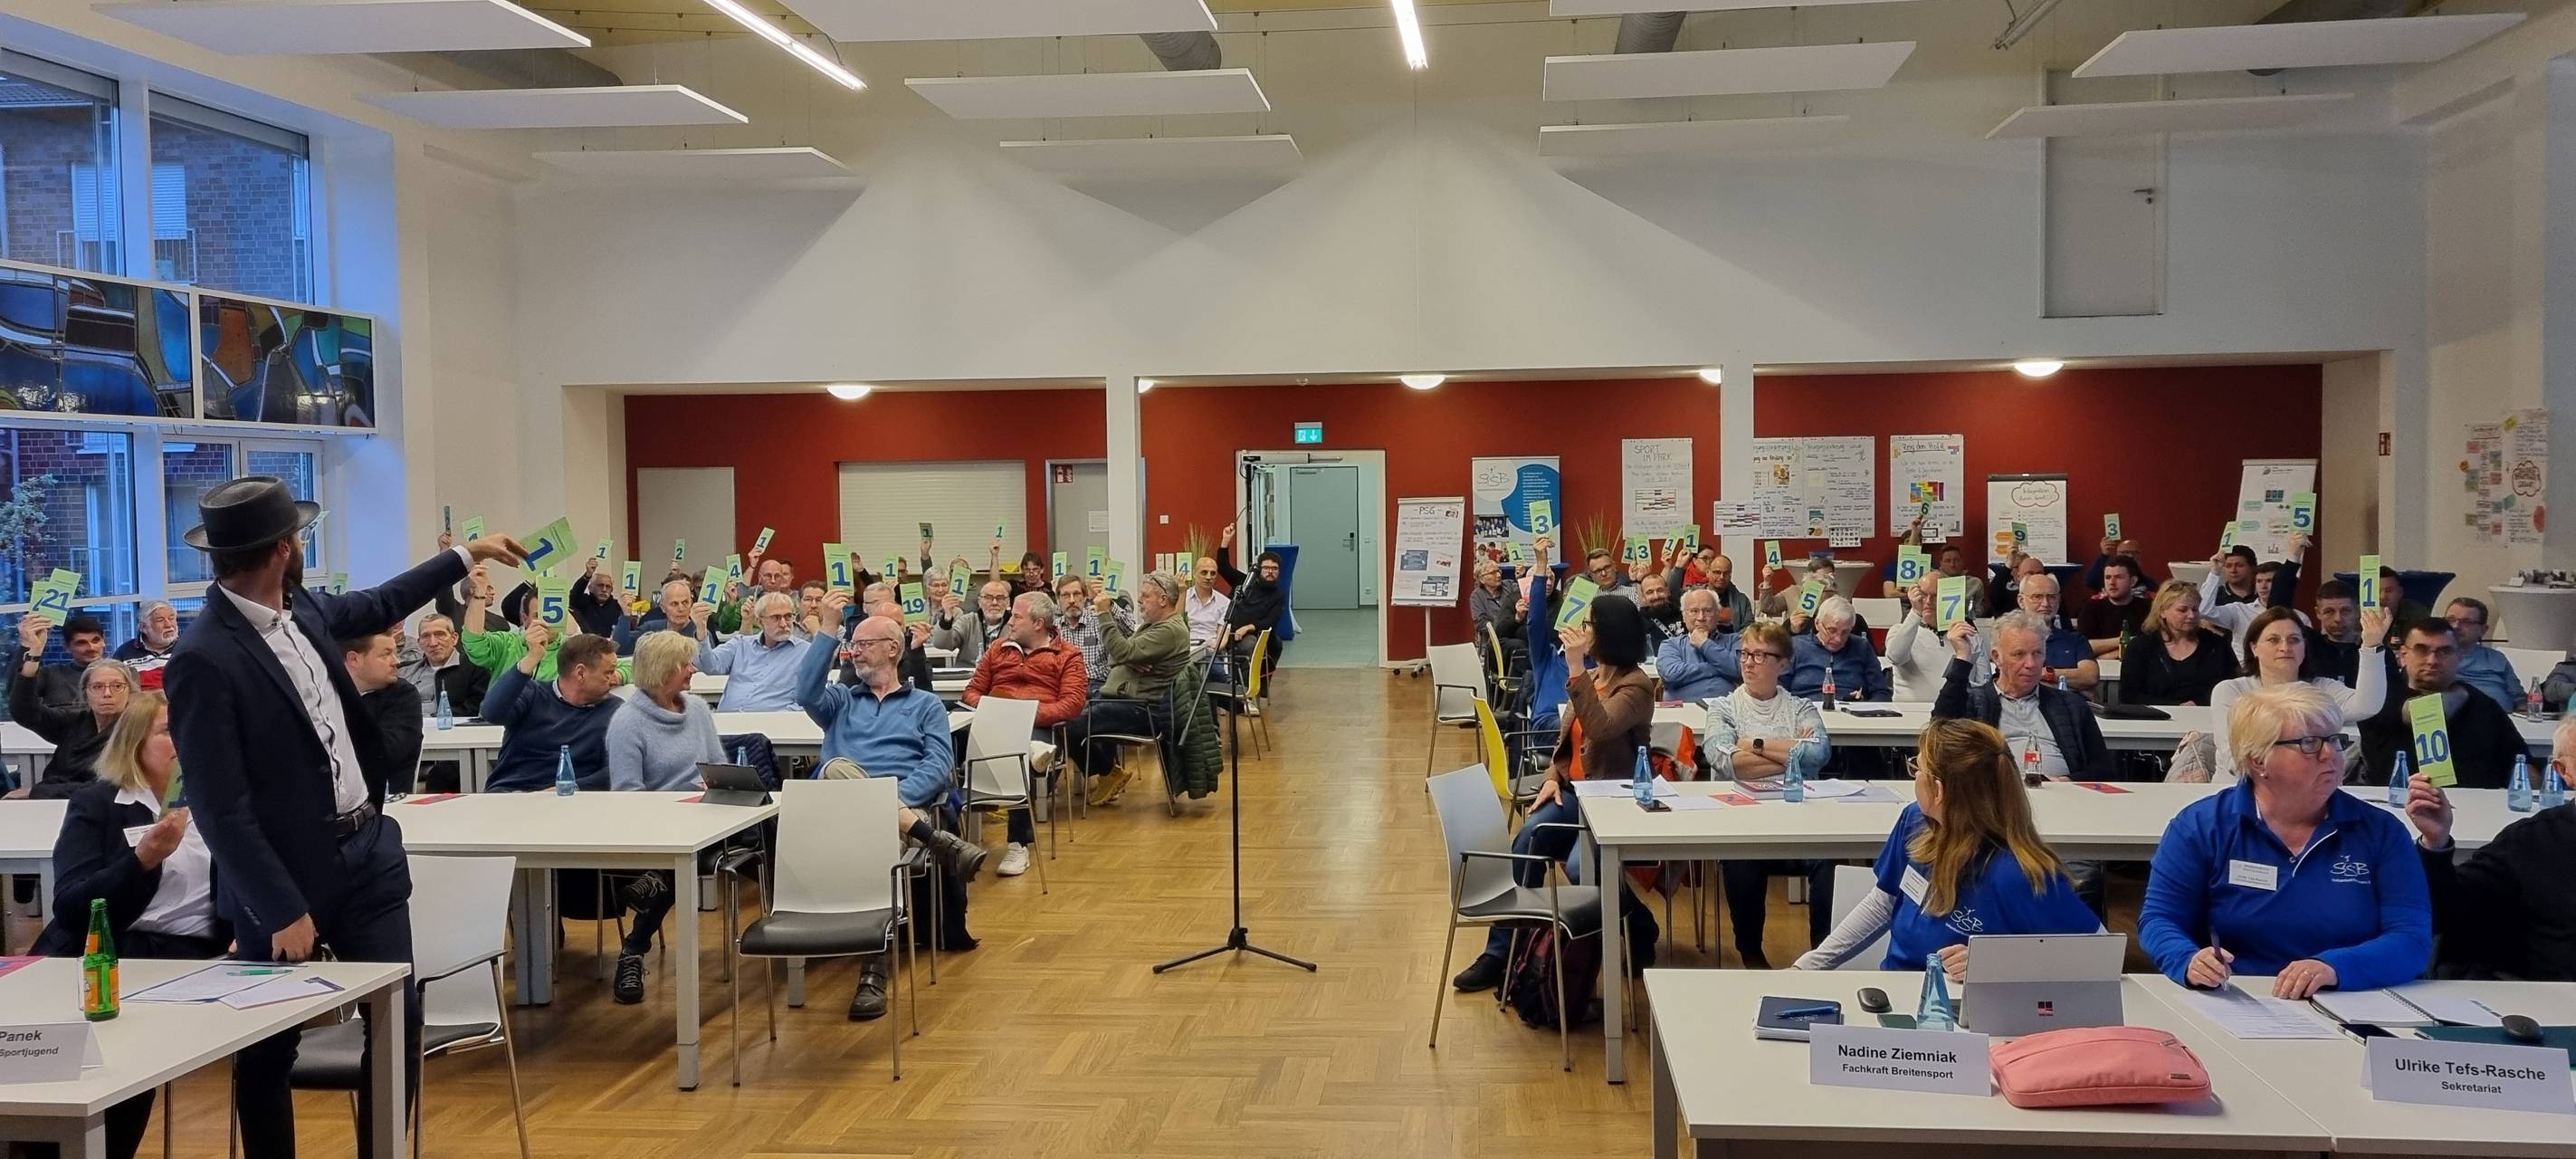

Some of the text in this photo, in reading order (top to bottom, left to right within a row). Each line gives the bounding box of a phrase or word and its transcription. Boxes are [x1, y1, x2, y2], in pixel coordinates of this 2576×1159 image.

[1634, 445, 1660, 454] SPORT
[1418, 506, 1436, 515] PSG
[1921, 503, 1930, 515] 6
[1534, 515, 1550, 535] 3
[2293, 507, 2311, 528] 5
[996, 526, 1003, 538] 1
[2014, 531, 2026, 541] 9
[2107, 523, 2118, 536] 3
[757, 537, 767, 548] 1
[1665, 539, 1674, 551] 1
[1685, 533, 1696, 548] 1
[2221, 532, 2233, 547] 1
[524, 537, 554, 572] 1
[596, 547, 606, 559] 1
[675, 547, 682, 560] 2
[1512, 550, 1522, 560] 1
[1637, 545, 1649, 559] 3
[1768, 551, 1779, 564] 4
[730, 564, 740, 578] 4
[831, 561, 851, 587] 1
[885, 563, 896, 577] 1
[1054, 562, 1064, 576] 1
[1089, 559, 1102, 576] 1
[1900, 560, 1917, 580] 8
[625, 573, 636, 589] 1
[951, 579, 964, 595] 1
[1104, 574, 1117, 592] 1
[702, 581, 717, 604] 1
[2362, 578, 2376, 607] 1
[41, 589, 71, 612] 21
[902, 598, 925, 615] 19
[1801, 593, 1817, 610] 5
[1942, 595, 1961, 620] 7
[542, 597, 564, 624] 5
[1563, 597, 1586, 623] 7
[2415, 729, 2449, 766] 10
[0, 1030, 43, 1042] Panek
[0, 1047, 59, 1058] Sportjugend
[1837, 1044, 1957, 1064] Nadine Ziemniak
[1842, 1063, 1954, 1079] Fachkraft Breitensport
[2394, 1058, 2546, 1081] Ulrike Tefs-Rasche
[2440, 1080, 2502, 1094] Sekretariat
